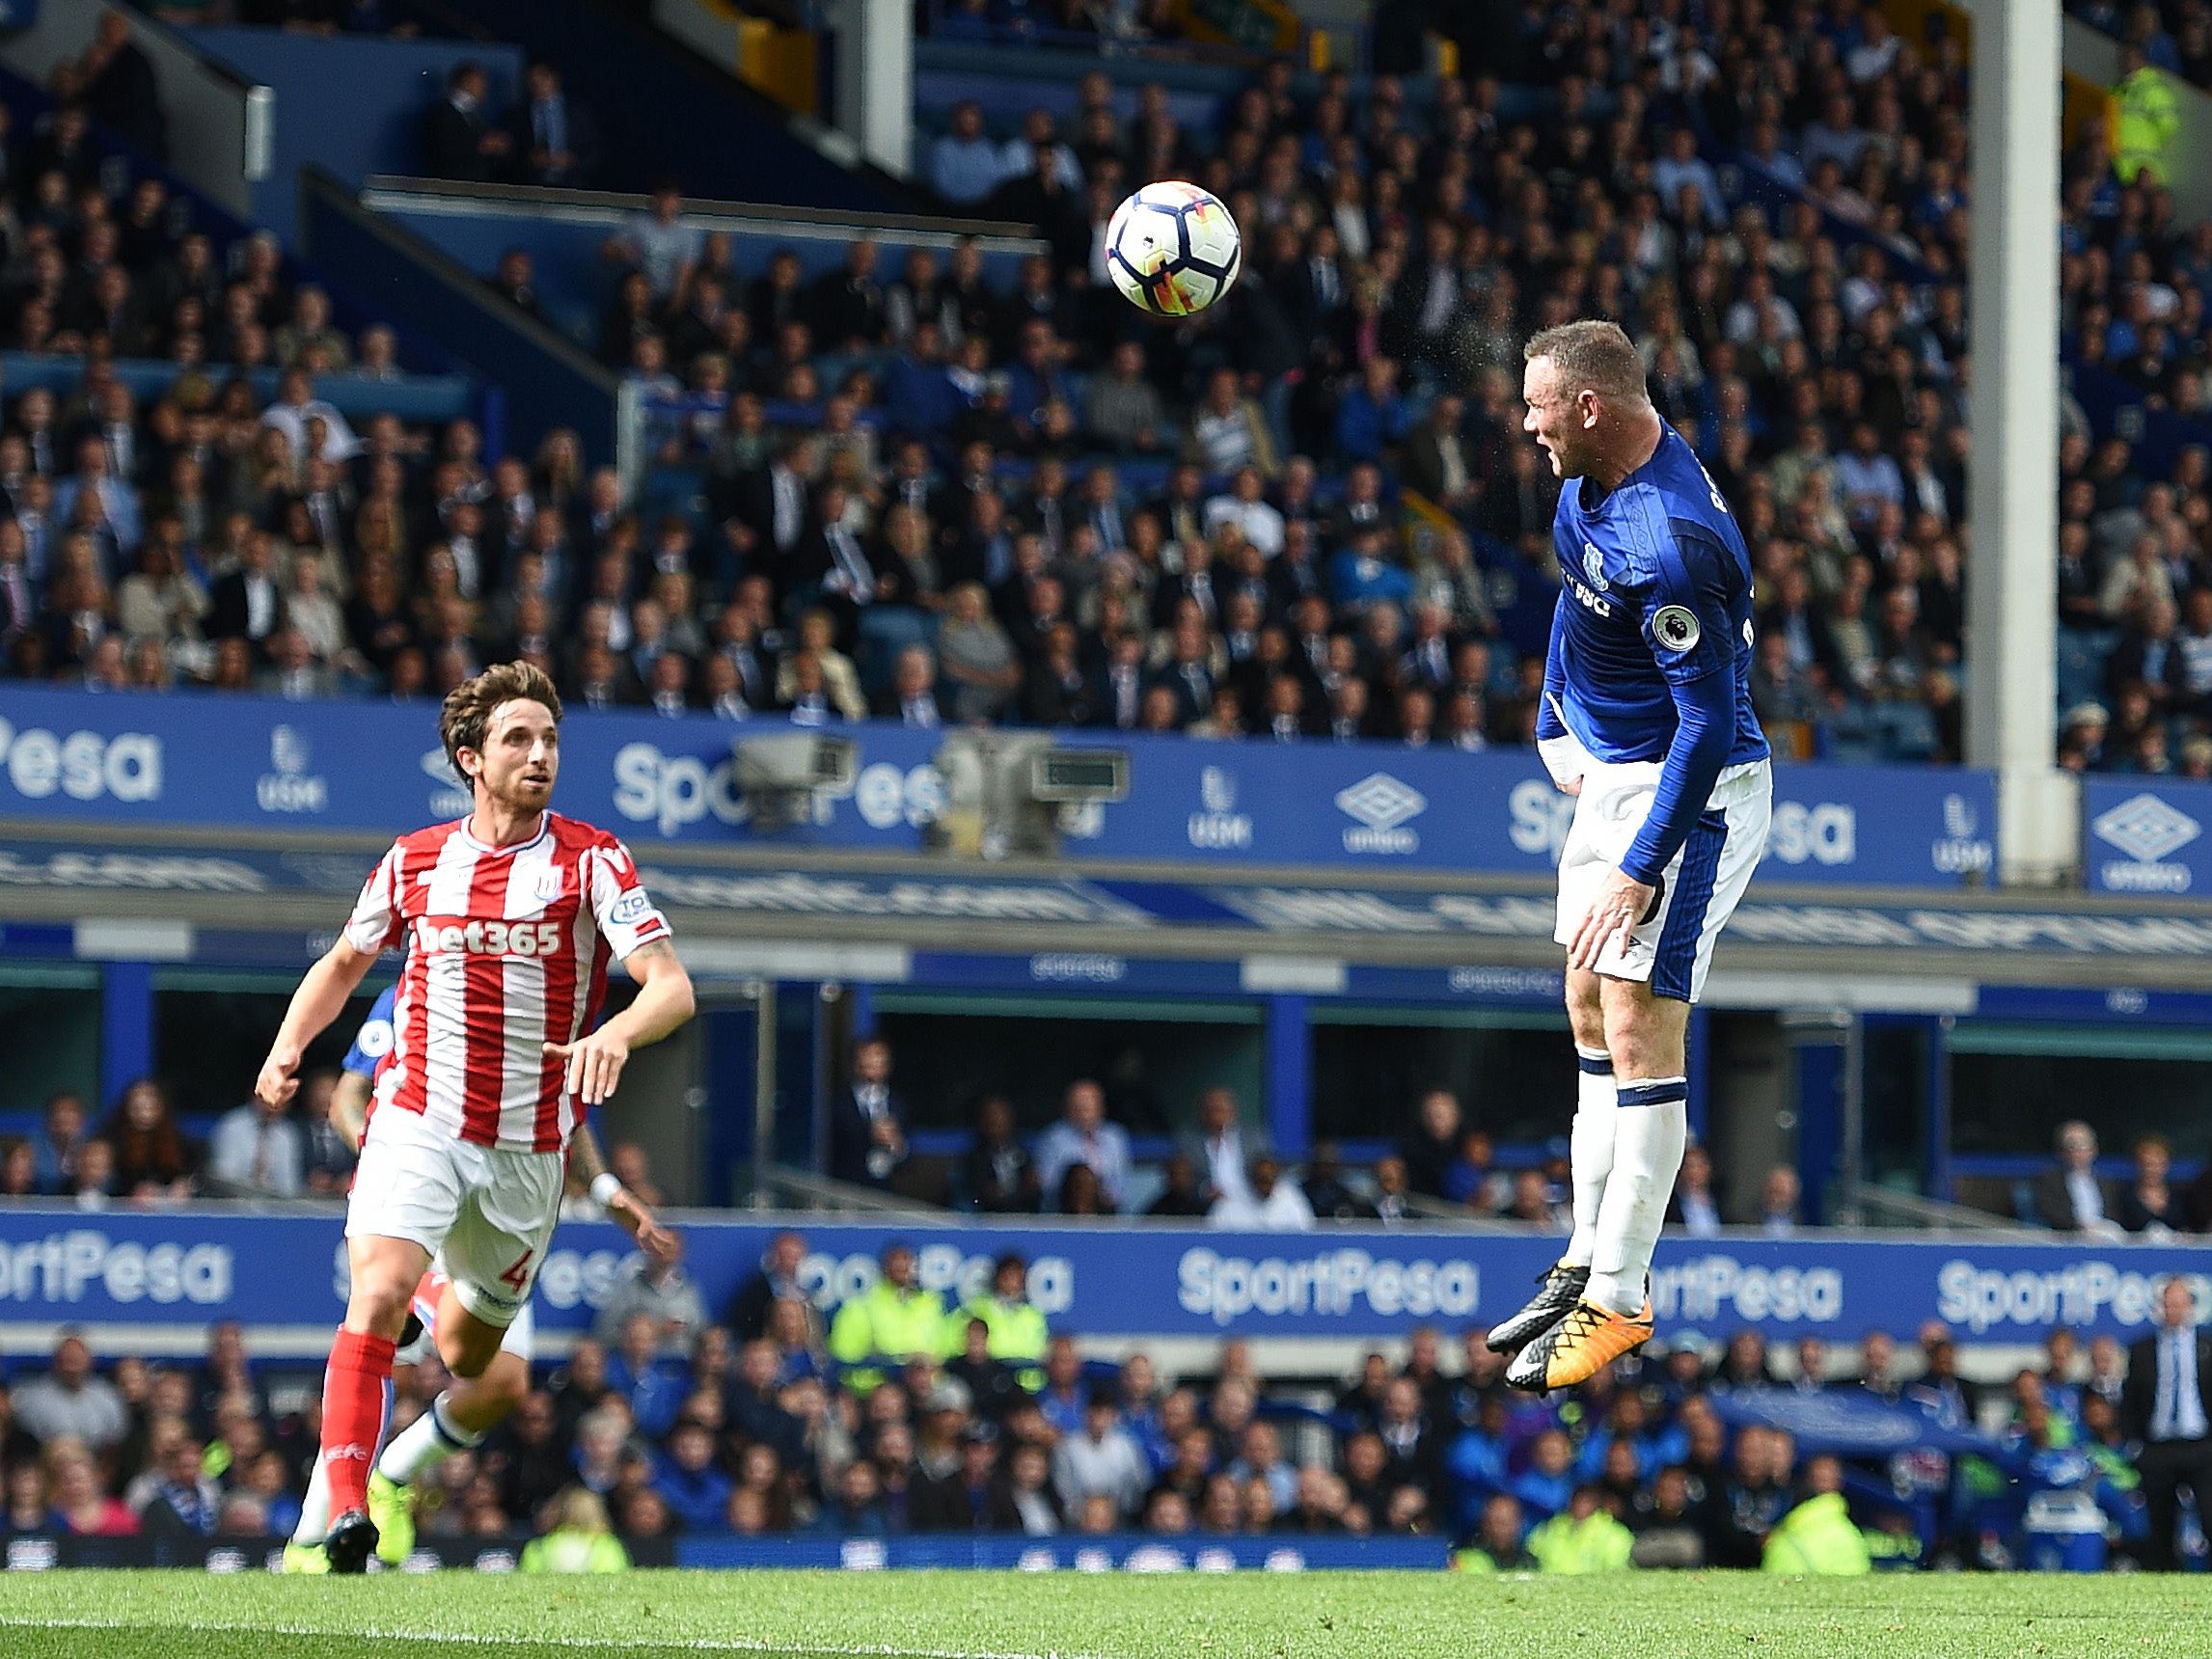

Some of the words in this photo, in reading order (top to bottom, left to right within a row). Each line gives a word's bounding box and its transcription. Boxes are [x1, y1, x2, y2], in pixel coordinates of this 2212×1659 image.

[417, 916, 560, 956] bet365
[499, 1249, 533, 1293] 4
[1177, 1246, 1481, 1326] SportPesa
